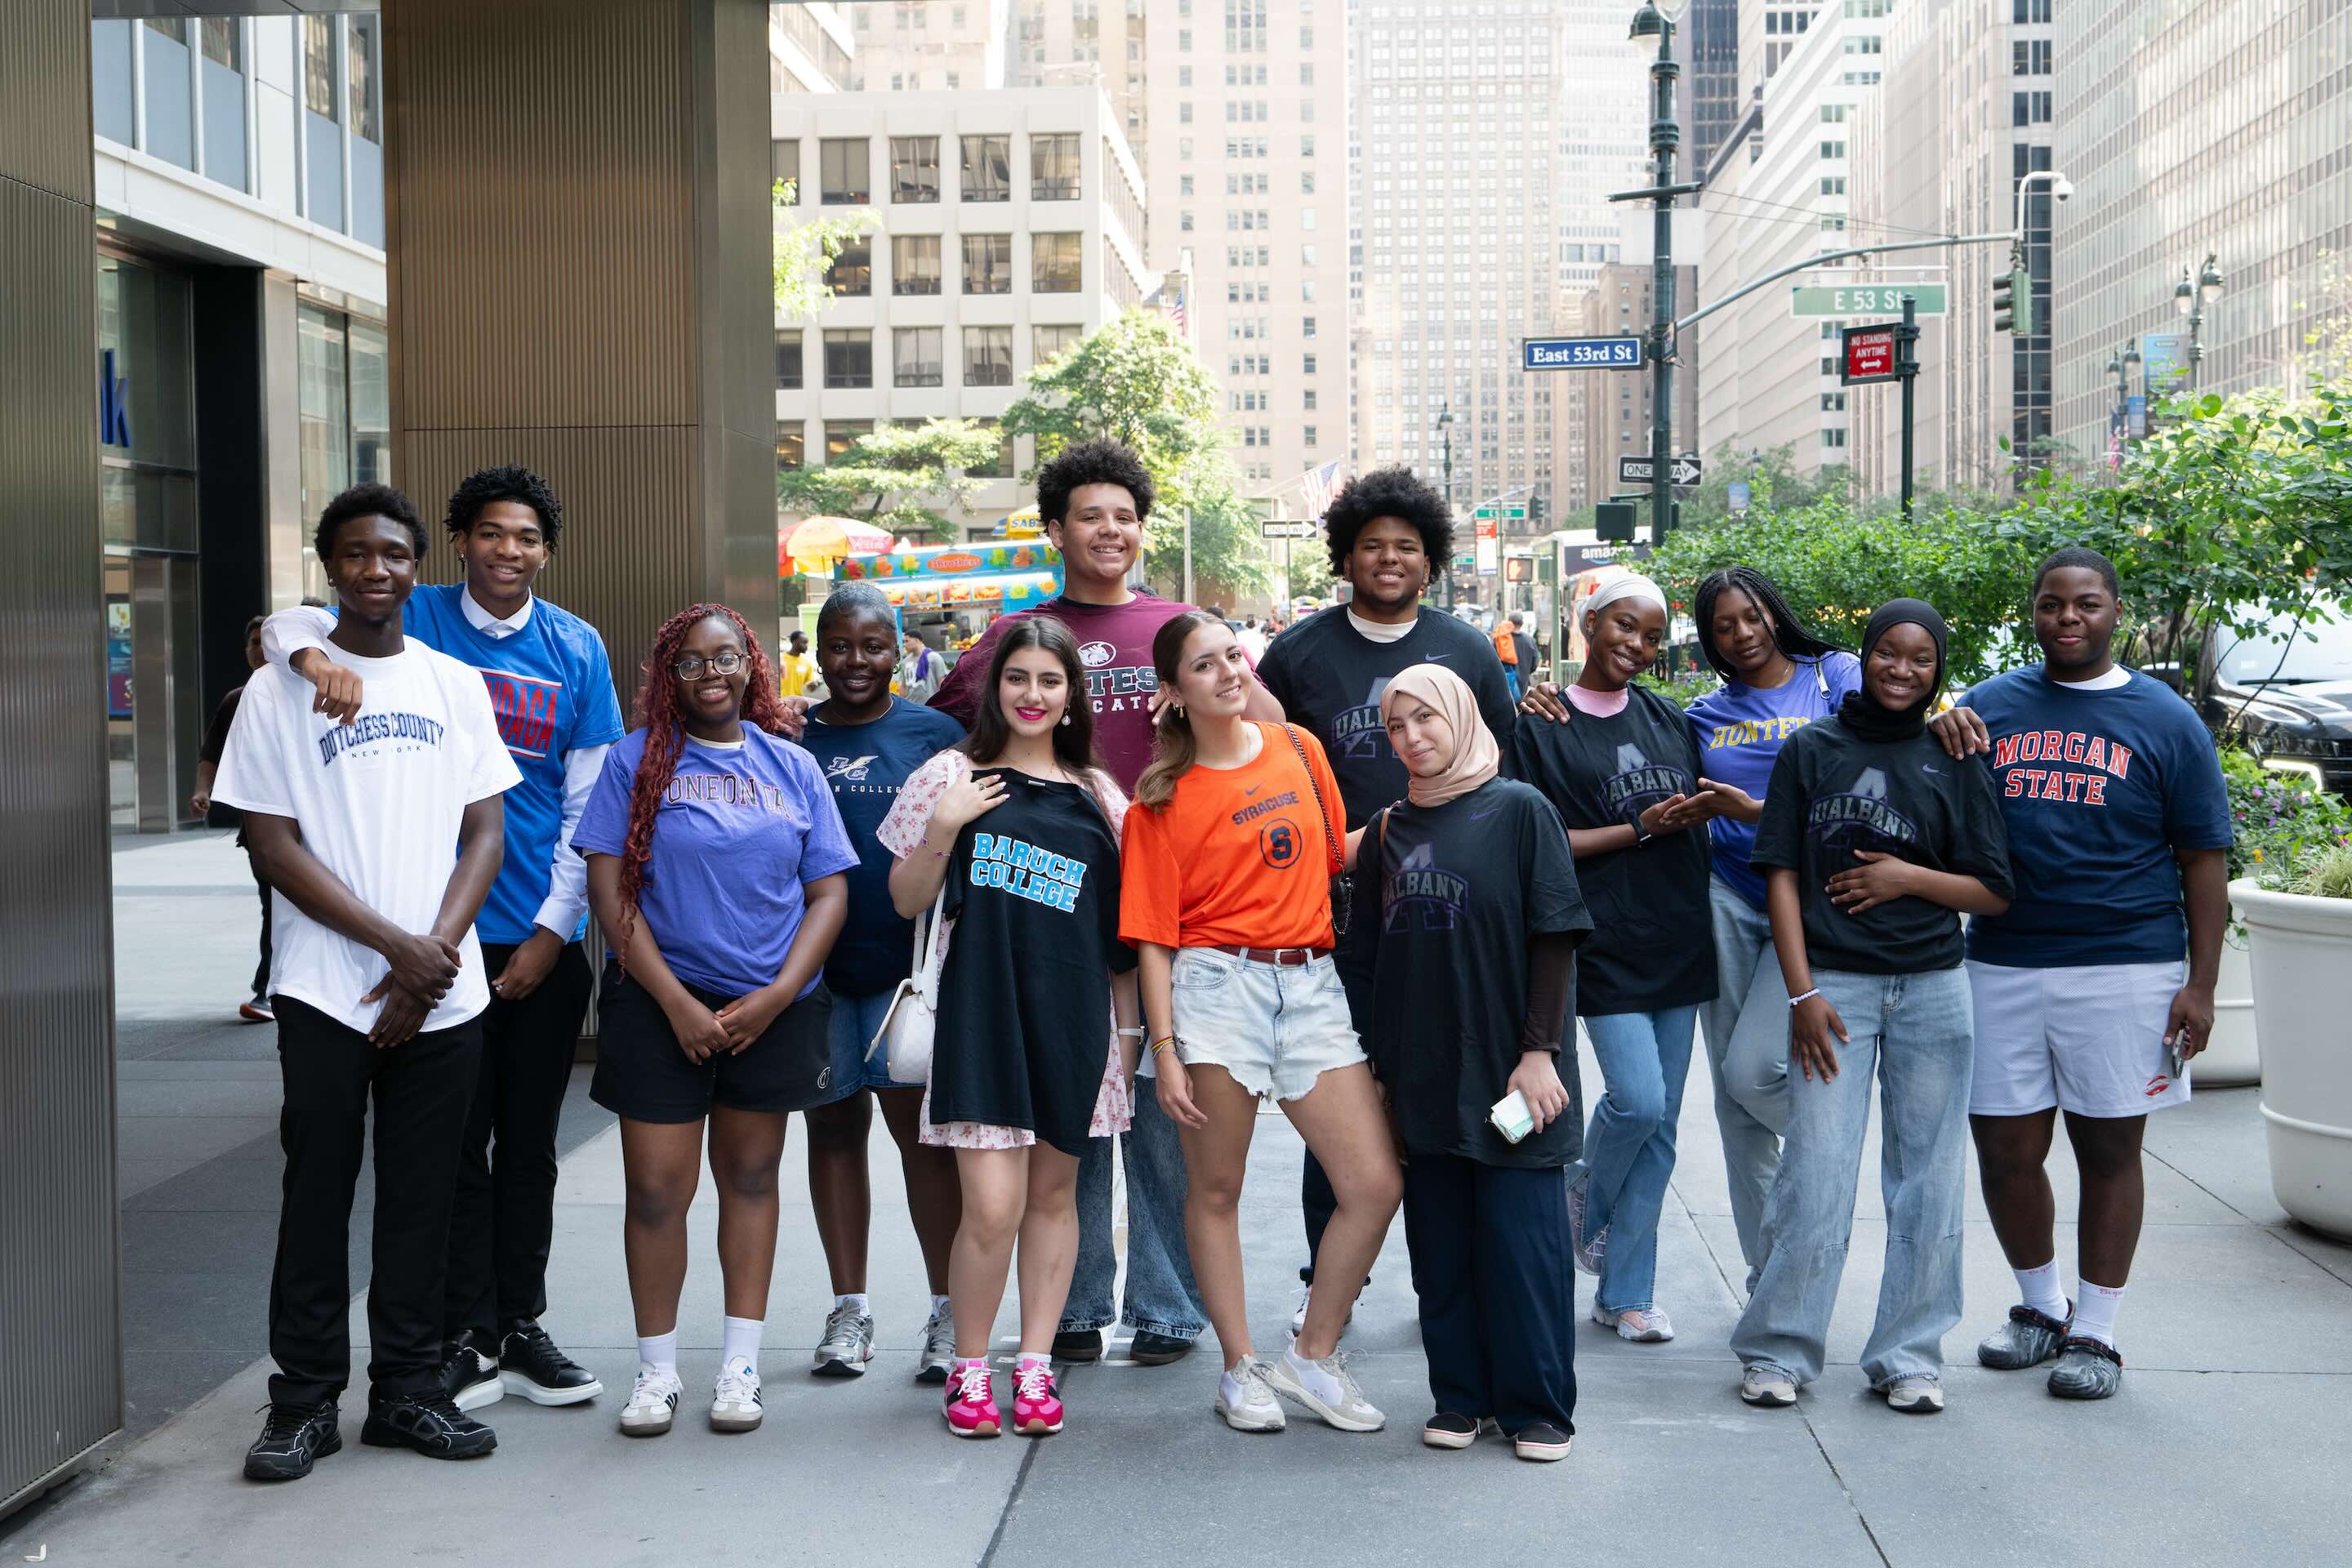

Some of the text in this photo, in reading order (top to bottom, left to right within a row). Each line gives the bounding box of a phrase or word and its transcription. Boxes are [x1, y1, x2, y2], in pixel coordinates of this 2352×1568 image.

[1834, 289, 1903, 310] E 53 St
[1533, 344, 1633, 363] East 53rd St
[1851, 332, 1892, 346] NO STANDING
[1855, 345, 1887, 359] ANYTIME
[1627, 465, 1690, 477] ONE AY
[1085, 666, 1160, 697] TES
[318, 711, 443, 766] DUTCHESS COUNTY
[351, 745, 421, 758] NEW ORK
[1993, 731, 2132, 779] MORGAN
[666, 774, 791, 820] ONEONTA
[851, 785, 902, 794] COLLEG
[2005, 768, 2108, 806] STATE
[1232, 791, 1300, 826] SYRACUSE
[973, 832, 1088, 888] BARUCH
[1269, 826, 1292, 861] S
[969, 859, 1080, 913] COLLEGE
